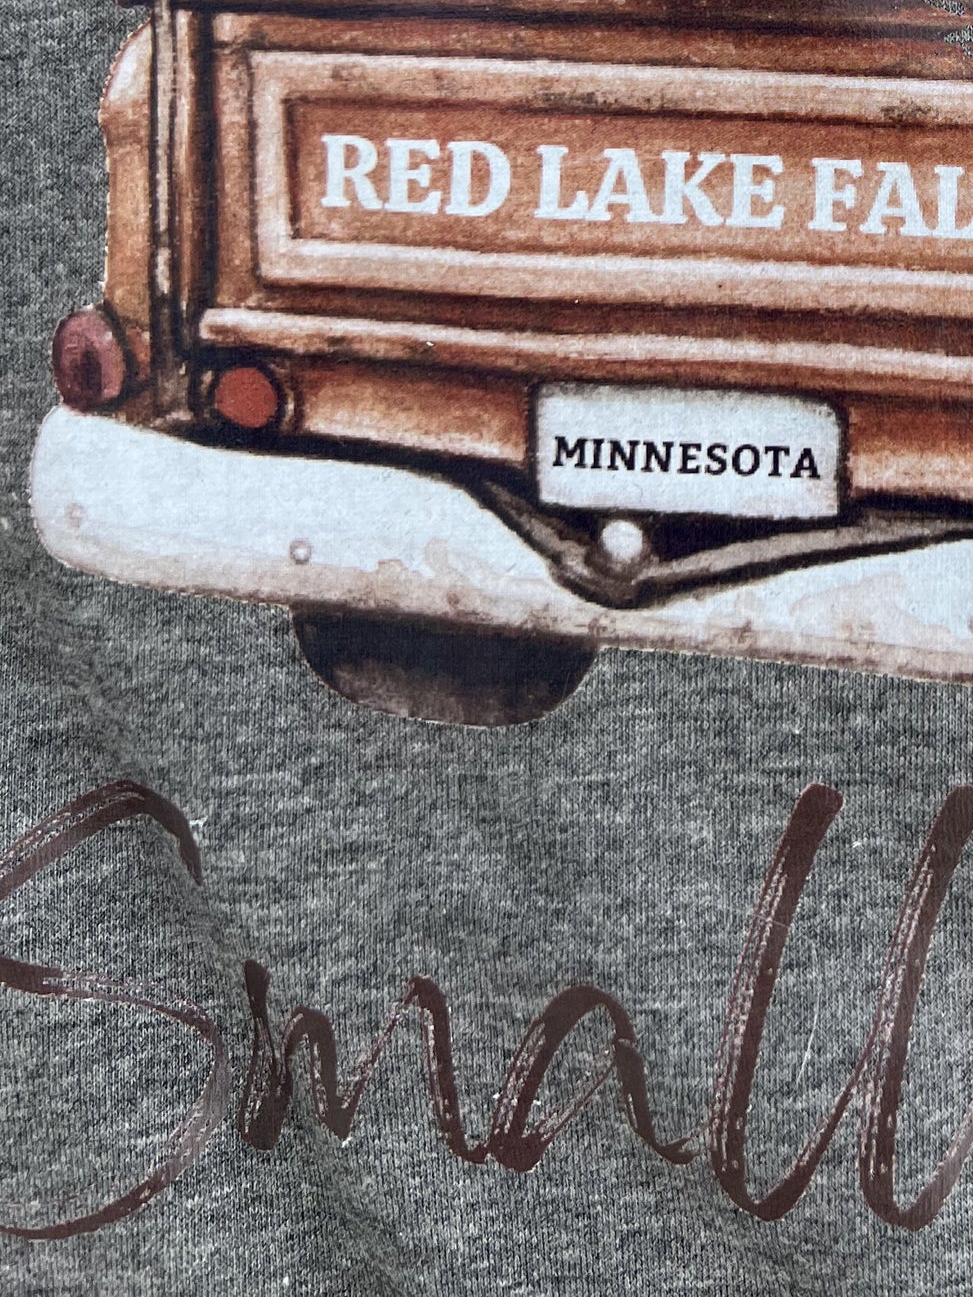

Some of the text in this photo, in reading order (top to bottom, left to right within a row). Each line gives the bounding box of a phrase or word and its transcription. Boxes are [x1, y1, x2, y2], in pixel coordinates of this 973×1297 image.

[319, 133, 512, 218] RED
[533, 142, 786, 228] LAKE
[551, 435, 822, 481] MINNESOTA
